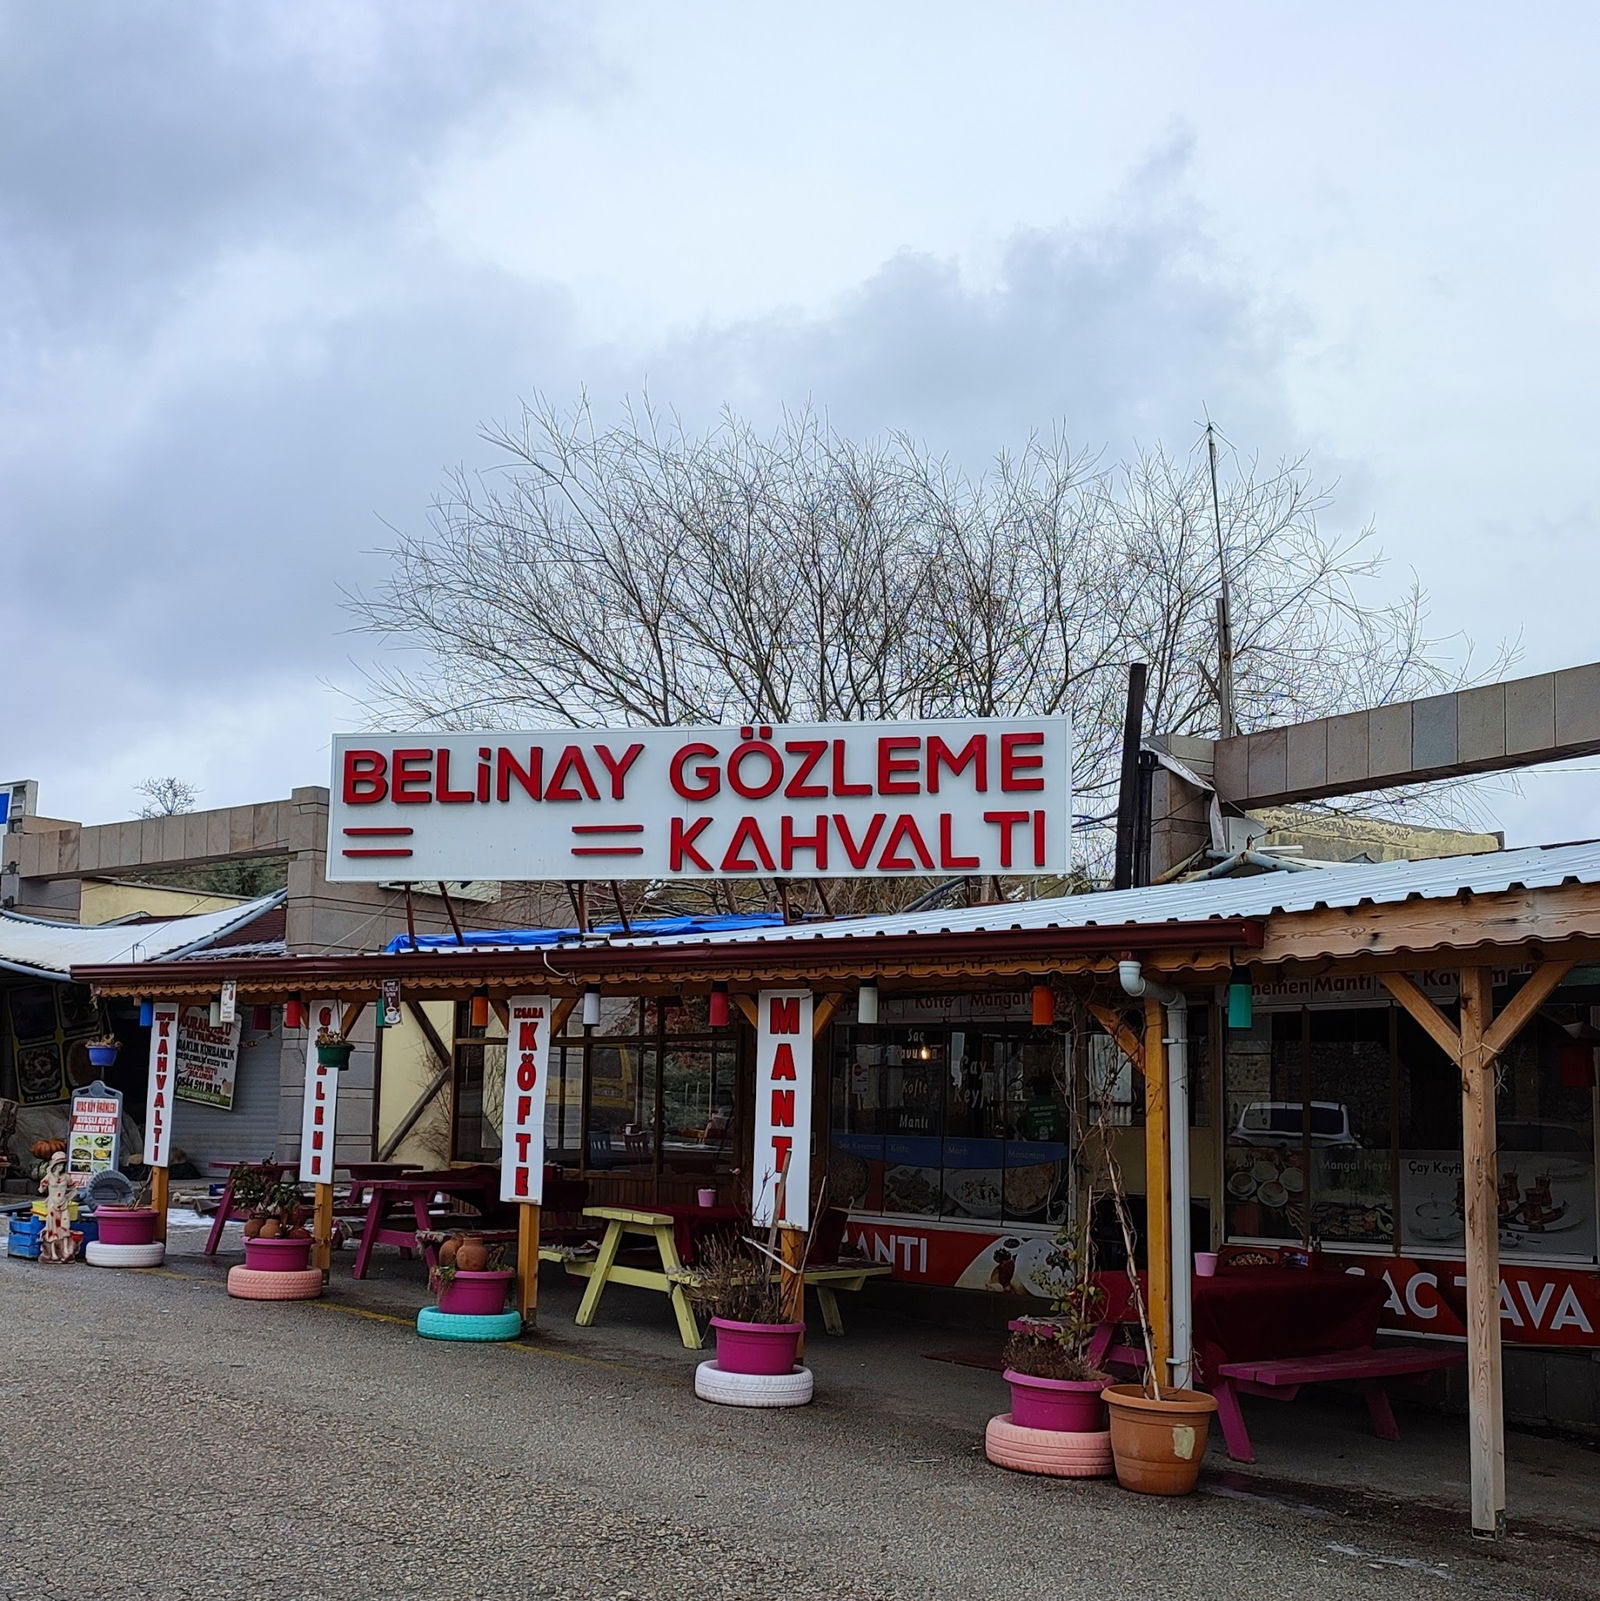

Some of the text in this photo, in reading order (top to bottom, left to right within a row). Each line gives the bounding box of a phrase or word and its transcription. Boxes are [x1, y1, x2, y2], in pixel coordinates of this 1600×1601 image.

[669, 726, 1044, 800] GÖZLEME
[670, 810, 1045, 871] KAHVALTI
[970, 991, 1026, 1009] Mangal
[153, 1021, 171, 1162] KAHVALTI
[514, 1022, 539, 1196] KÖFTE
[769, 997, 801, 1221] MANTI
[1320, 1159, 1360, 1174] Mangal
[1408, 1160, 1462, 1177] Çay Keyfi
[841, 1230, 928, 1273] ANTI
[1345, 1266, 1594, 1333] AC AVA
